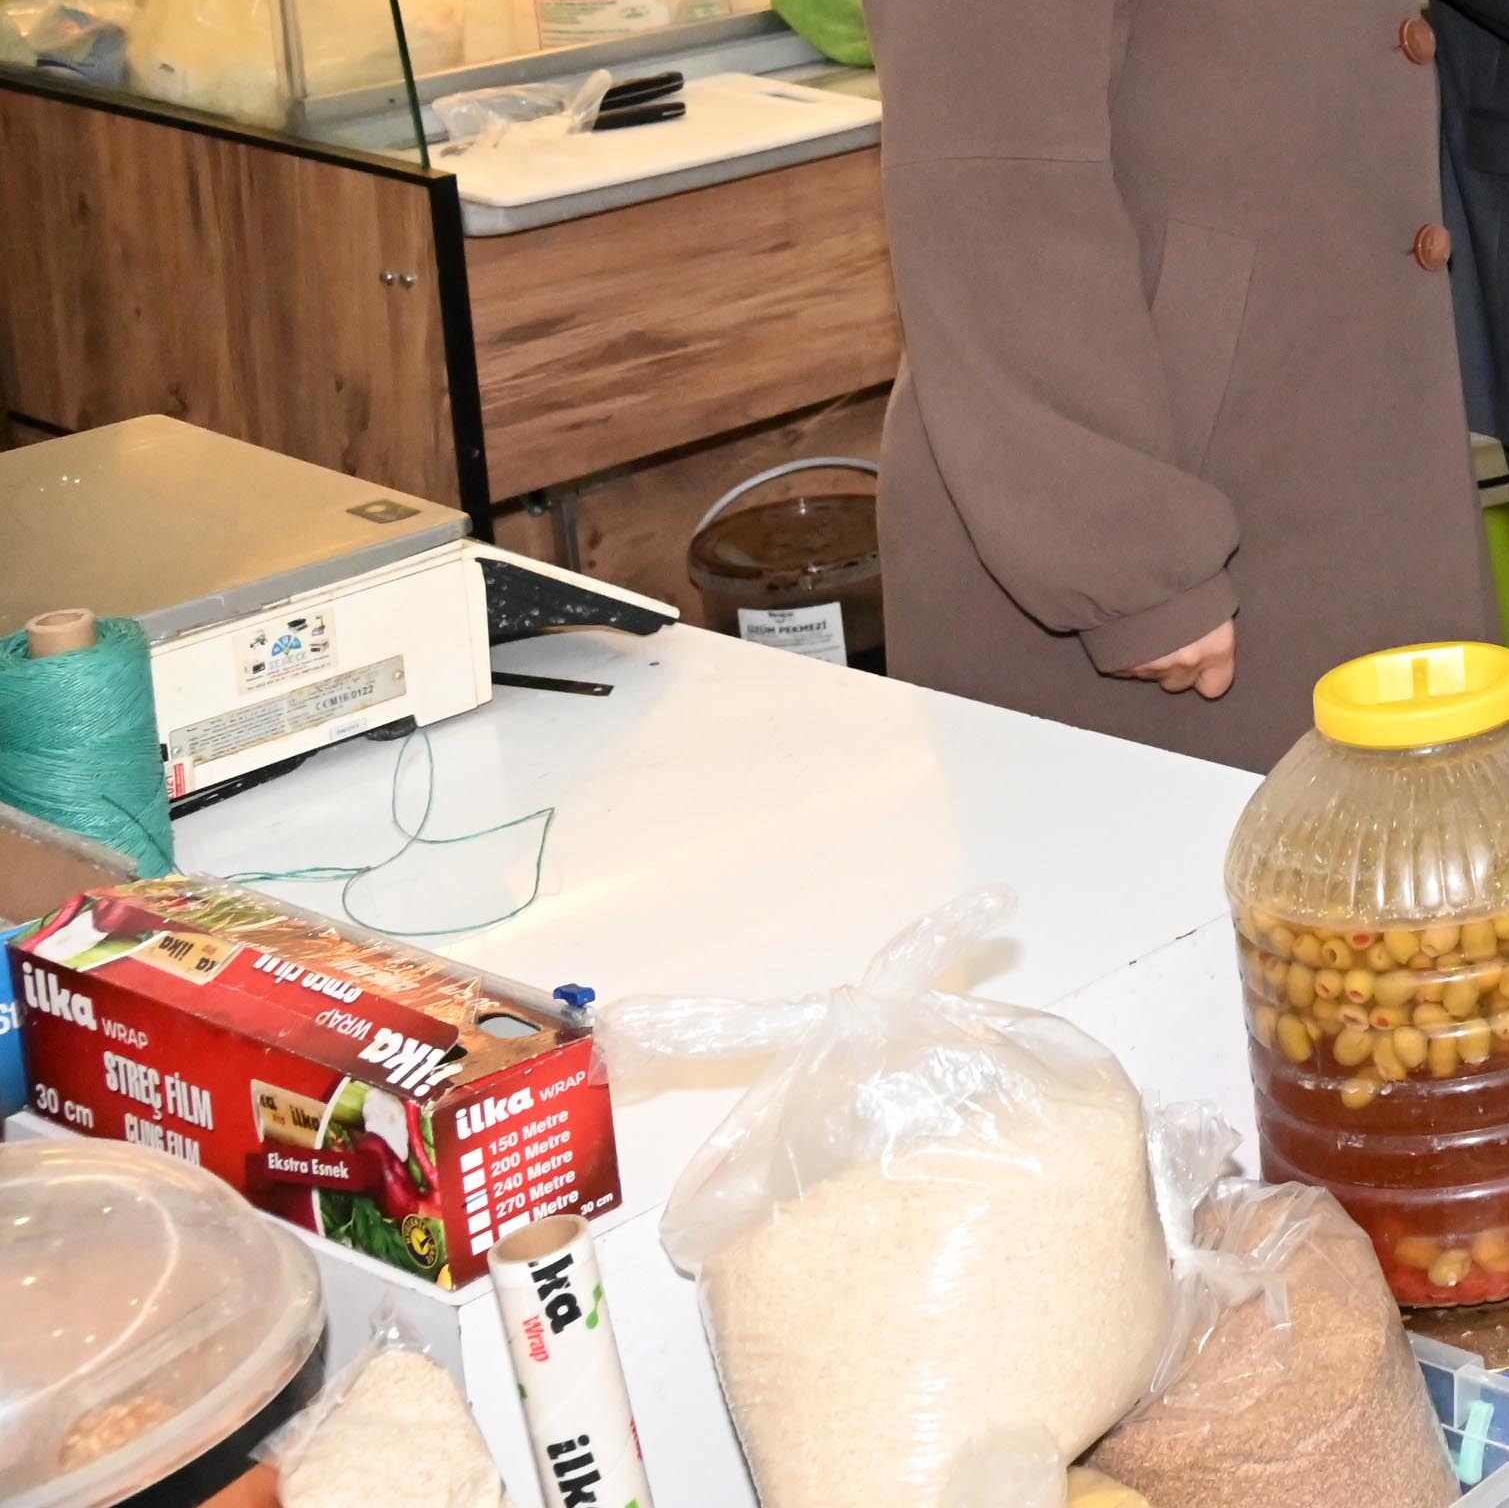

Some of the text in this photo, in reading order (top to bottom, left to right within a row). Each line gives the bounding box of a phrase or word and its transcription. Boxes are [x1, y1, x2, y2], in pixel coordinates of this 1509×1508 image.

[22, 961, 97, 1031] ilka
[101, 1017, 148, 1050] WRAP
[315, 1007, 463, 1097] ilka WRAP
[35, 1083, 95, 1129] 30 cm
[103, 1050, 215, 1131] STREÇ FİLM
[455, 1070, 586, 1141] ilka WRAP
[488, 1110, 569, 1156] 150 Metre
[490, 1130, 571, 1178] 200 Metre
[267, 1152, 349, 1180] Ekstra Esnek
[493, 1150, 574, 1199] 240 Metre
[495, 1170, 576, 1219] 270 Metre
[532, 1190, 580, 1222] Metre
[580, 1192, 614, 1217] 30 cm
[522, 1314, 550, 1363] Wrap
[547, 1434, 602, 1508] ilk
